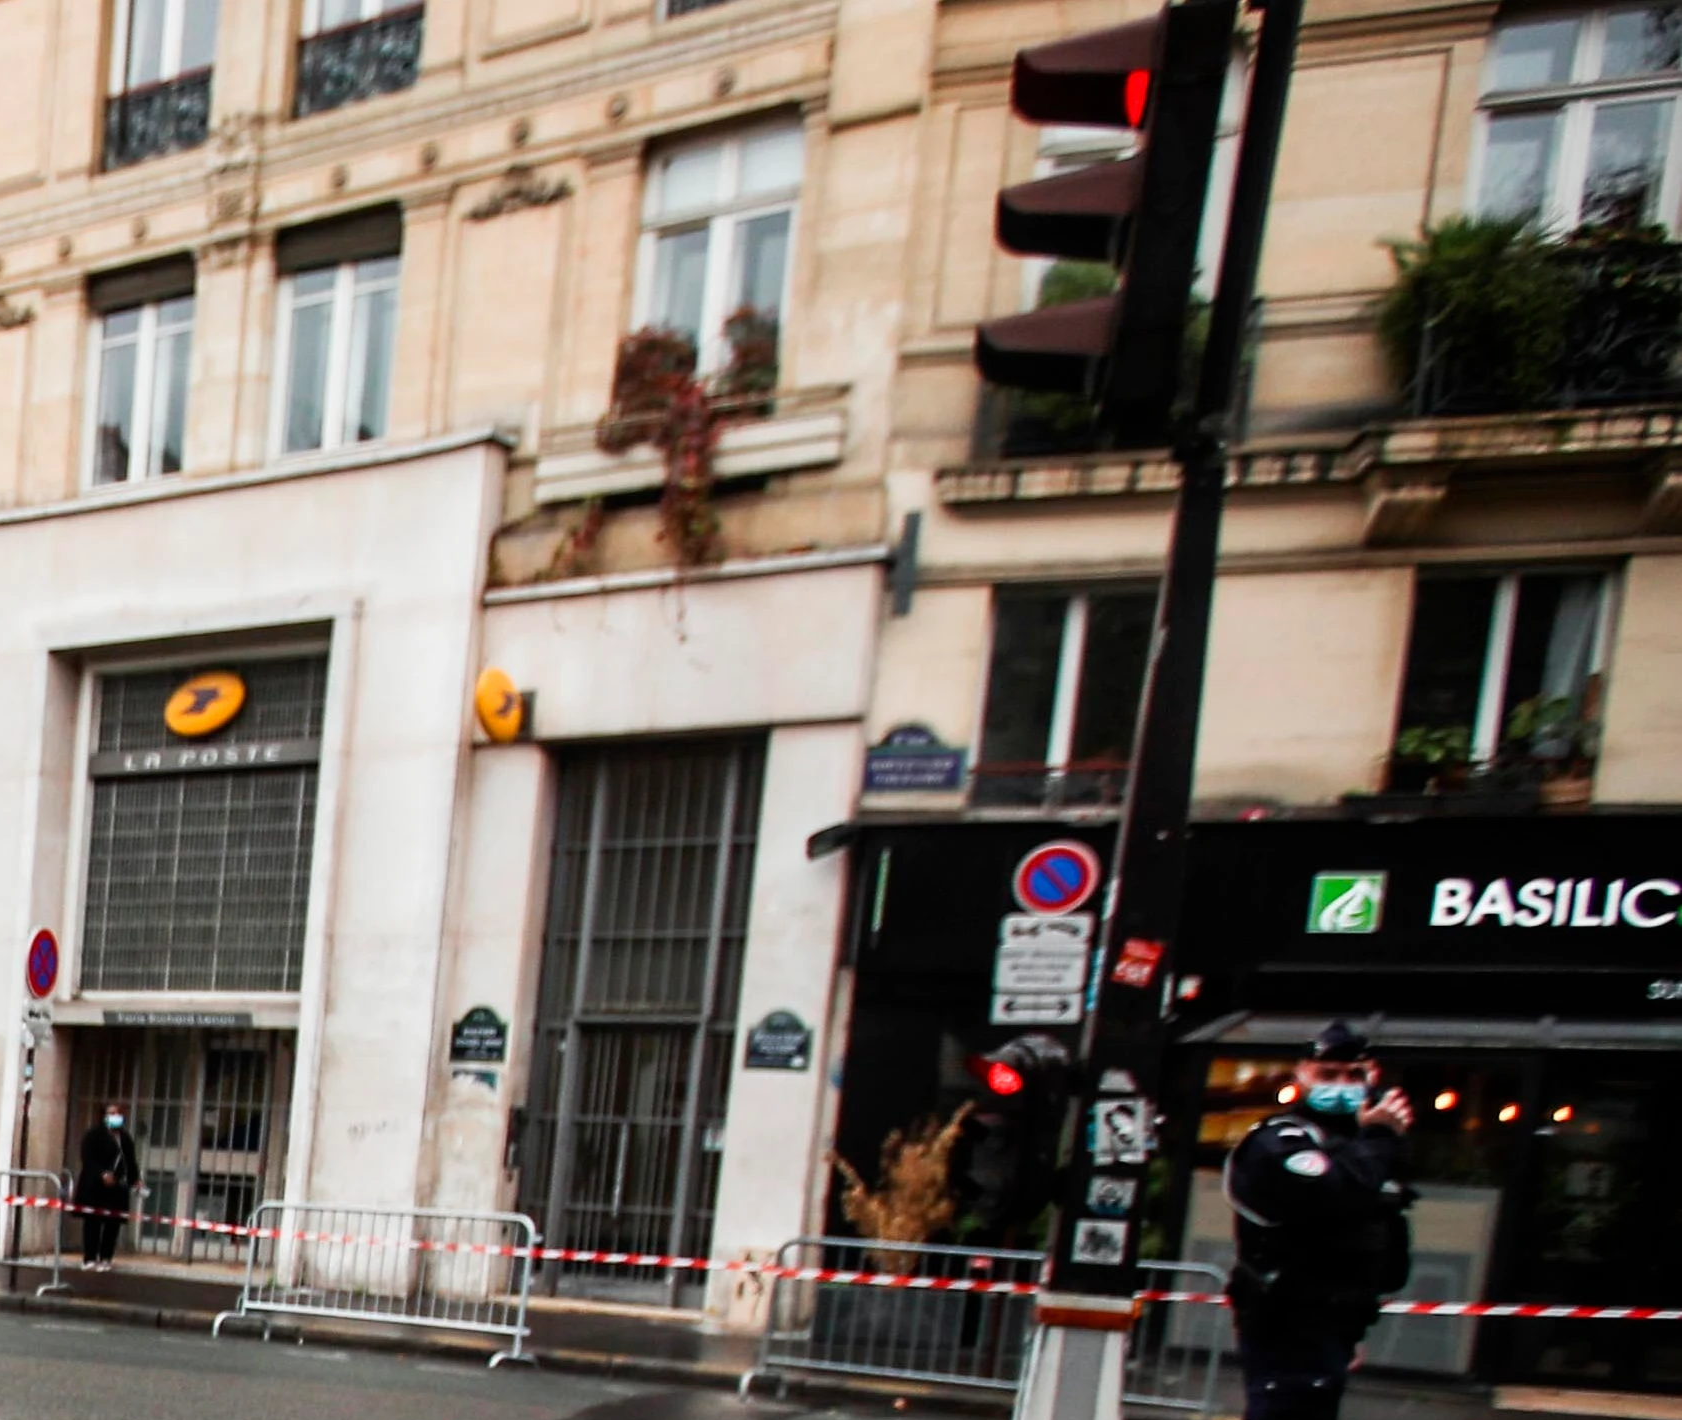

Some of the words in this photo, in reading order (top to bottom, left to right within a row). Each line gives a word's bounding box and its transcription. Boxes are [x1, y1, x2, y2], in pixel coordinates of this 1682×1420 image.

[123, 752, 162, 771] LA
[178, 743, 283, 768] POSTE
[1429, 877, 1682, 928] BASILIC
